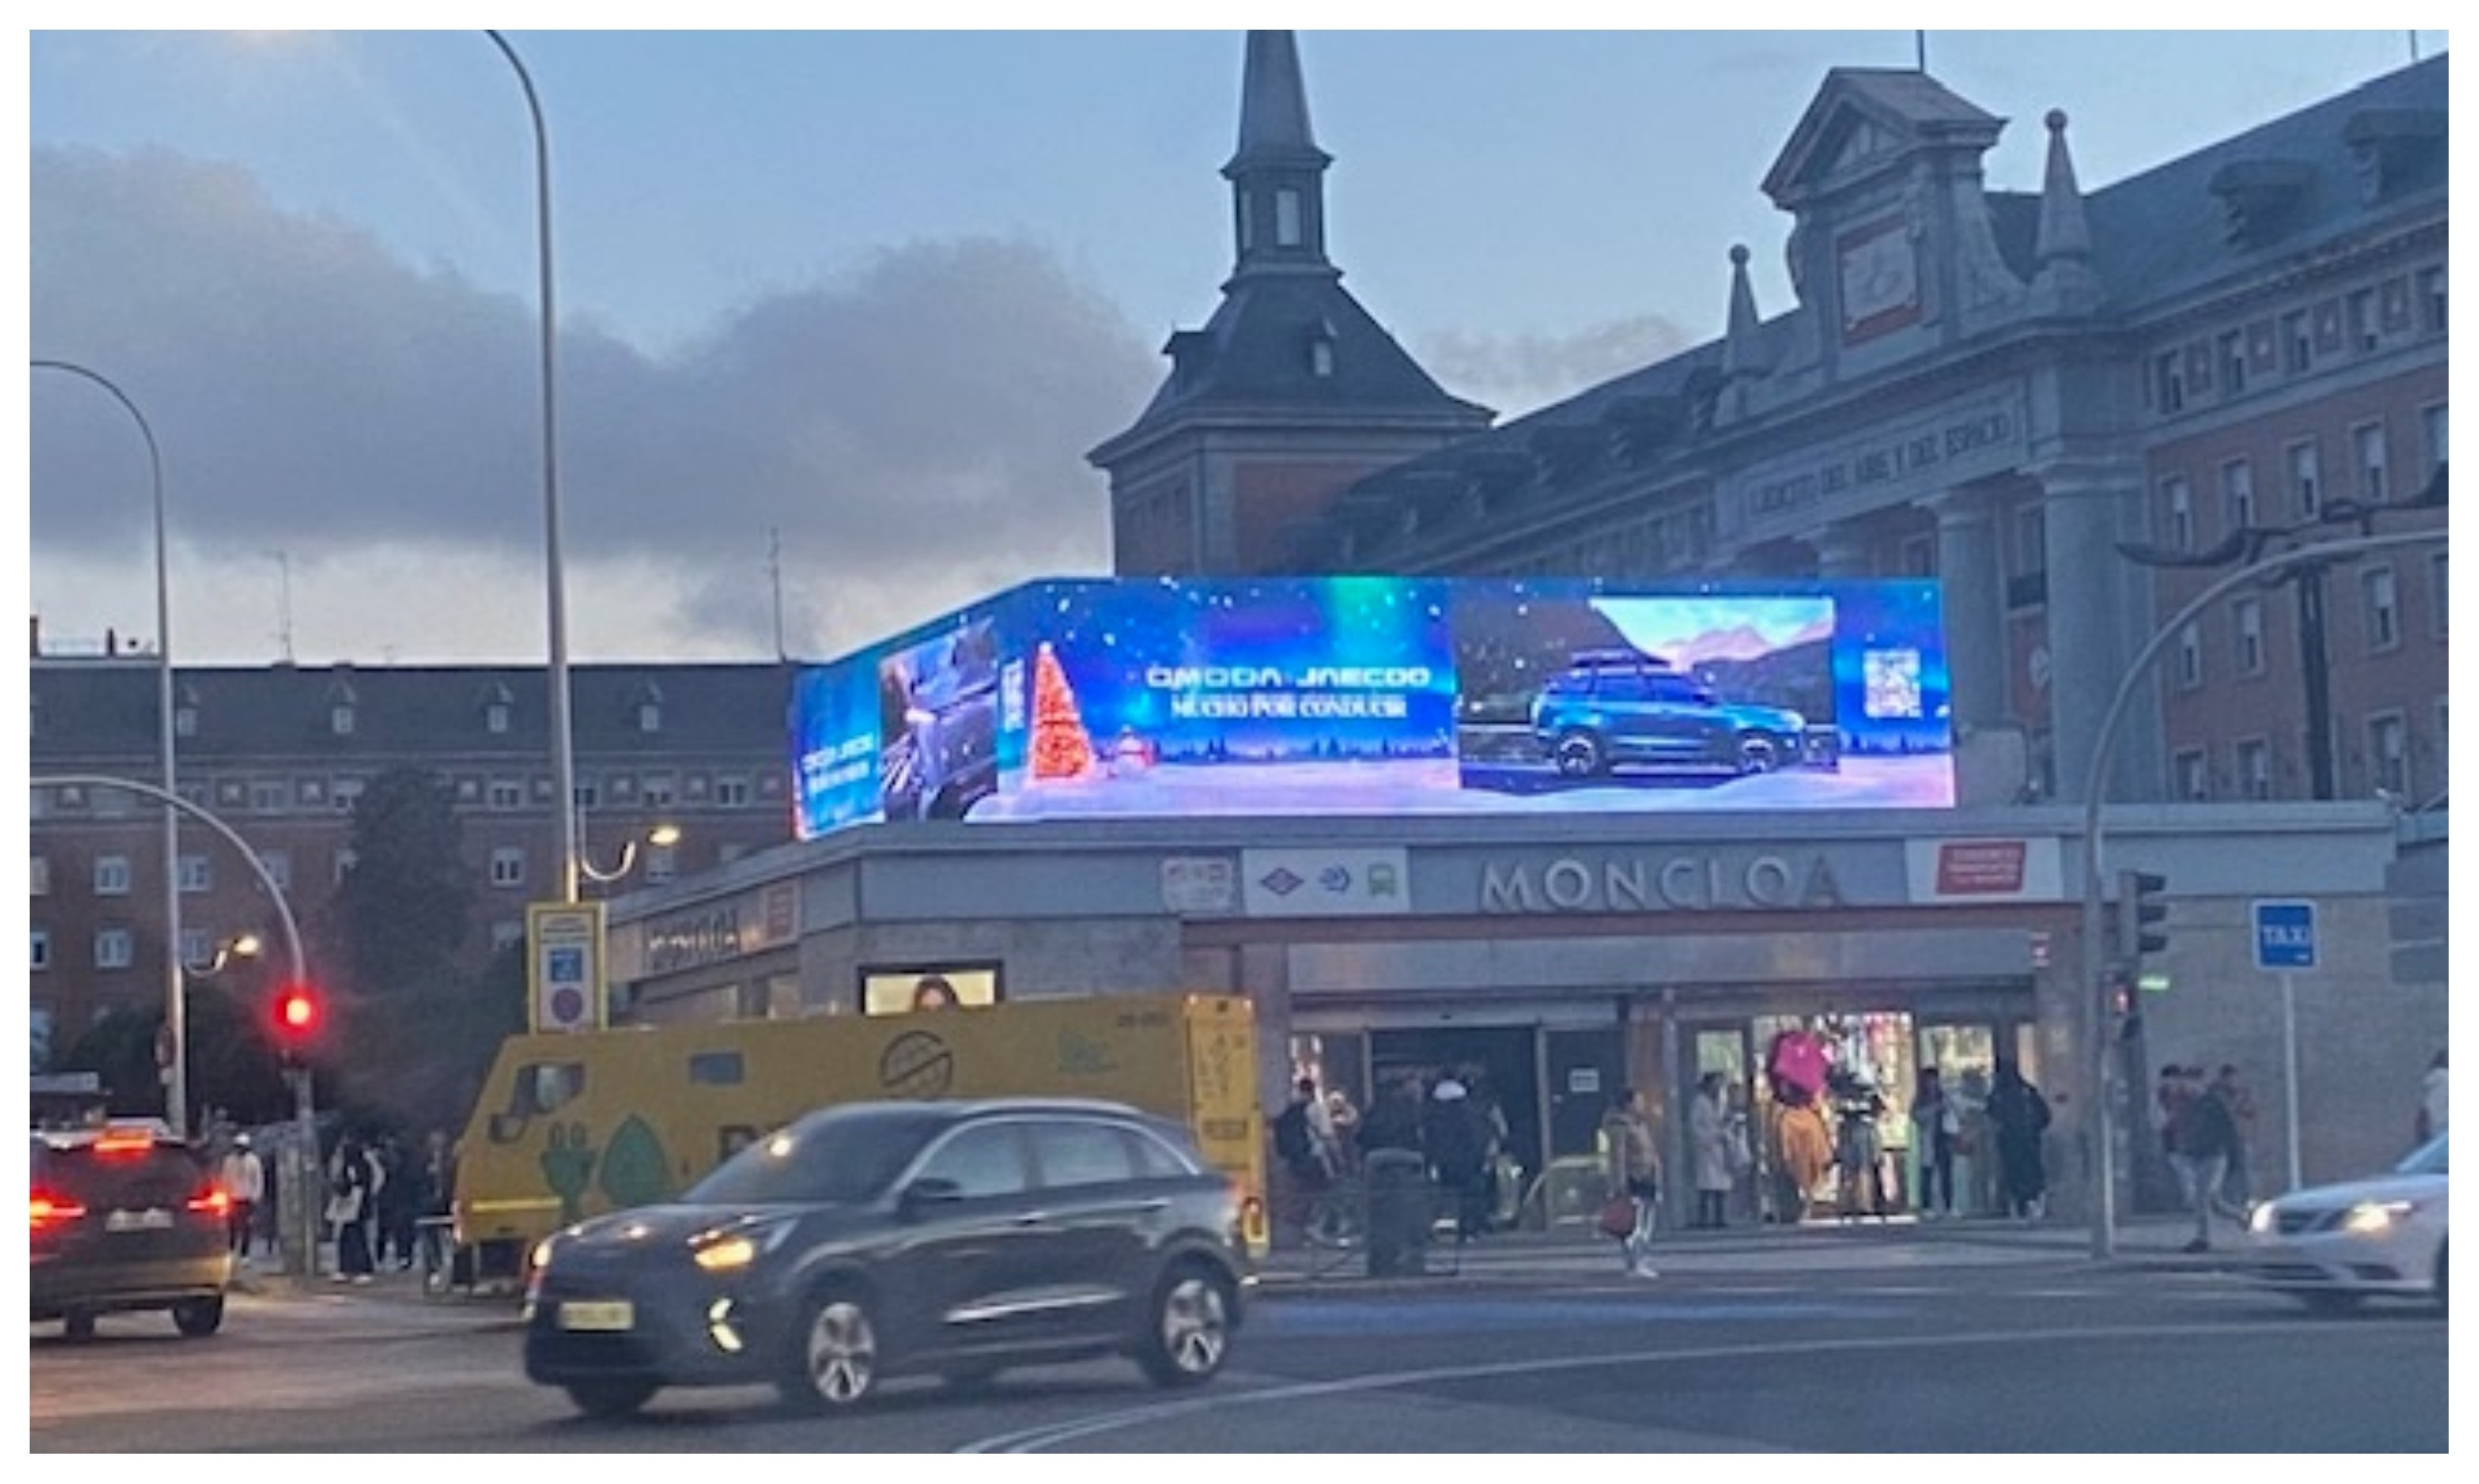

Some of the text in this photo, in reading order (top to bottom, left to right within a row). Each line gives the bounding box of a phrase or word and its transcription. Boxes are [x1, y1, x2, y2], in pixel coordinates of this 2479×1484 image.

[1296, 666, 1432, 688] JAECOO
[1170, 693, 1408, 718] MUCHO POR CONDUCIR
[1480, 854, 1845, 912] MONCLOA
[2261, 924, 2312, 949] TAXI
